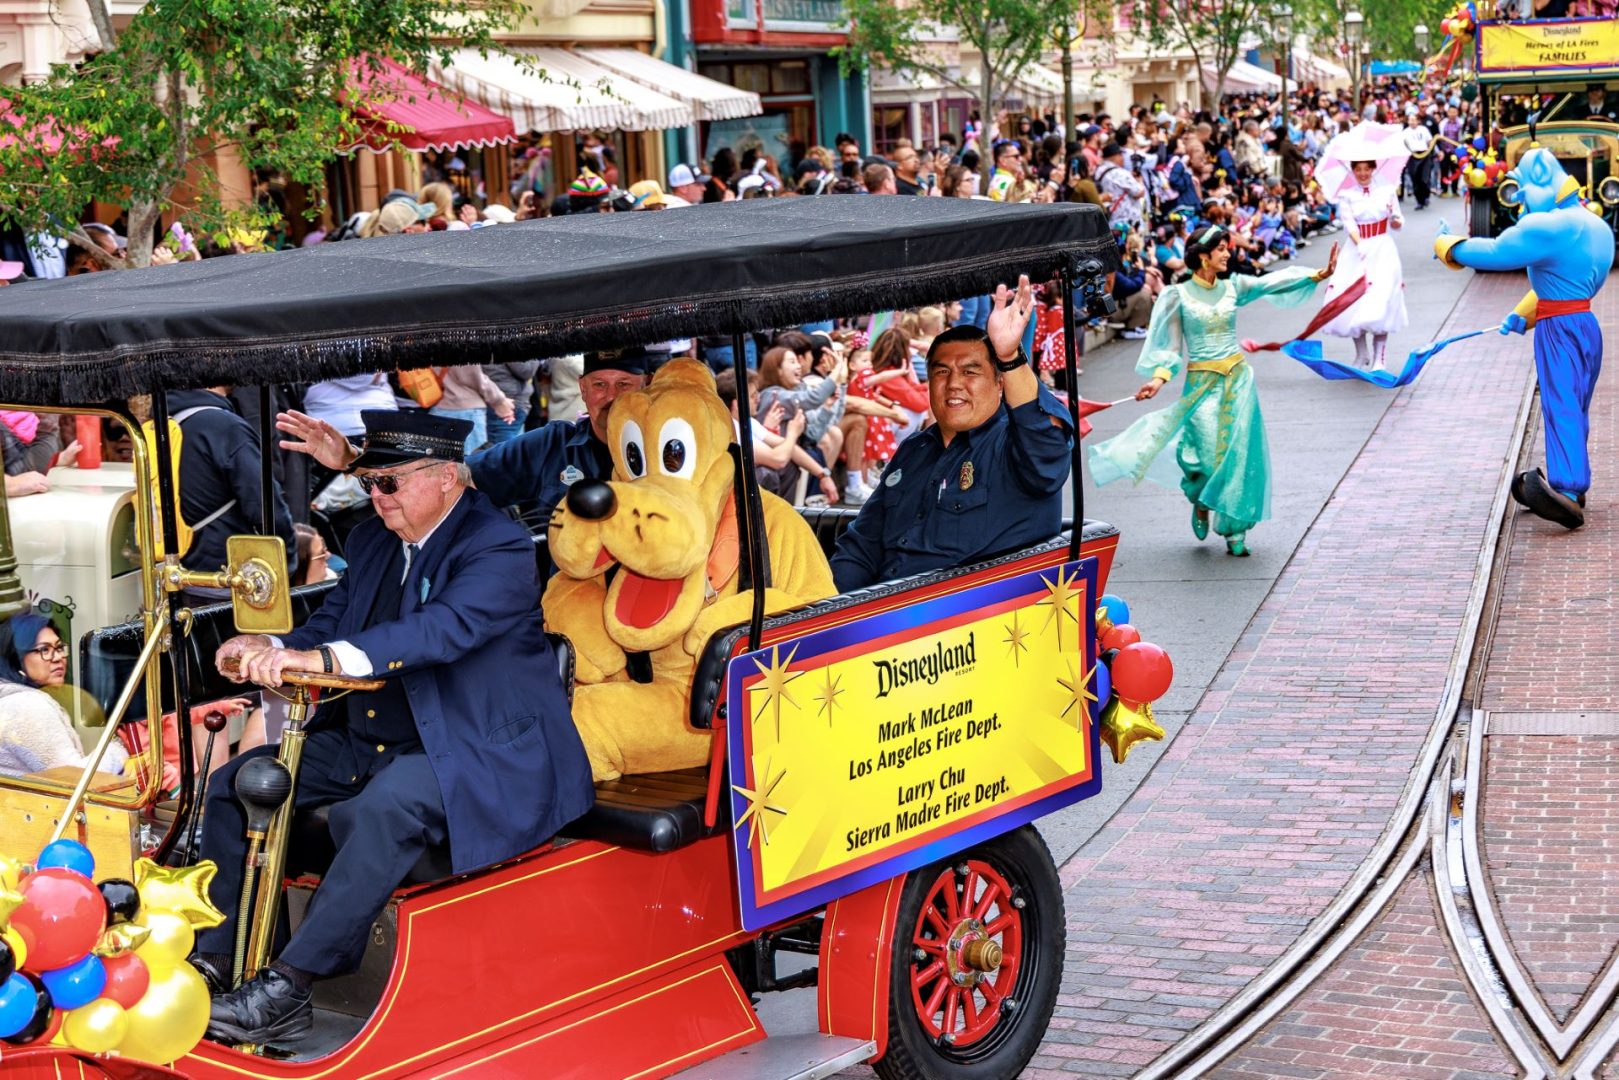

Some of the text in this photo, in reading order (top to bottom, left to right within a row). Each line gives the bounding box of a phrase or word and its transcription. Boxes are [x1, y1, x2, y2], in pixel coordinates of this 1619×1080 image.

[1543, 26, 1581, 37] Disneyland
[1555, 40, 1565, 49] of
[1579, 39, 1599, 47] Fires
[1539, 51, 1587, 62] FAMILIES
[872, 631, 976, 699] Disneyland
[955, 666, 975, 676] RESORT
[878, 699, 973, 743] Mark McLean
[849, 712, 1002, 780] Los Angeles Fire Dept.
[898, 766, 965, 806] Larry Chu
[846, 776, 1010, 852] Sierra Madre Fire Dept.
